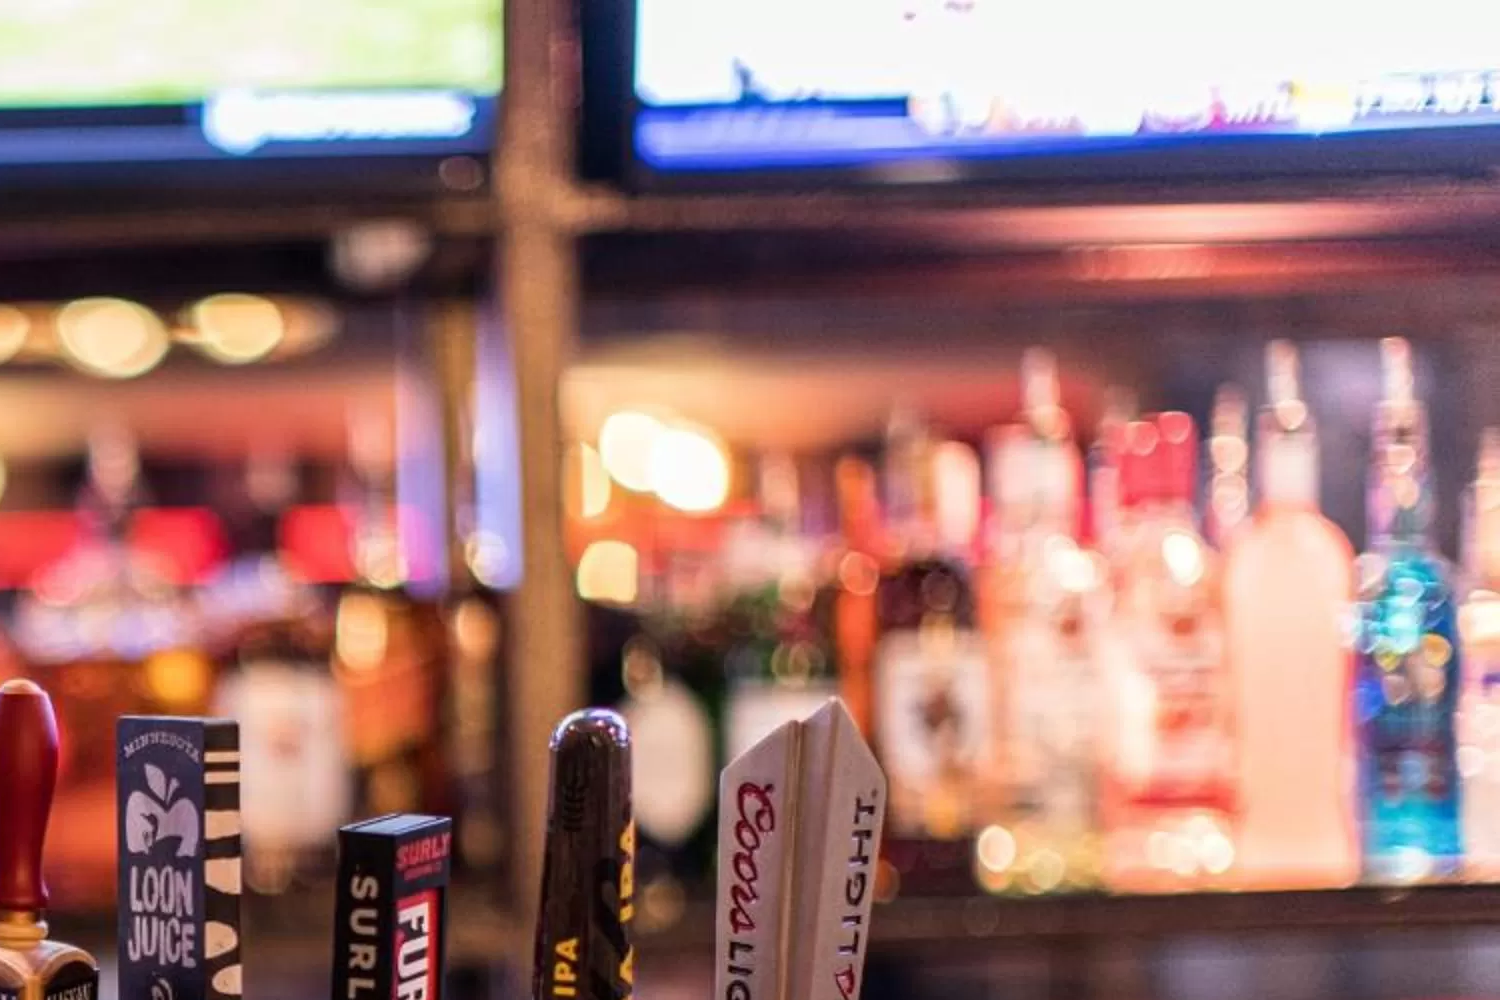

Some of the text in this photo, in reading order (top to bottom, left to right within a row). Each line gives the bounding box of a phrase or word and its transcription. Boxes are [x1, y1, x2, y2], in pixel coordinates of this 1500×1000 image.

[123, 732, 200, 764] MINNESOTA
[728, 780, 775, 936] Coors
[838, 797, 877, 957] LIGHT
[129, 865, 194, 917] LOON
[128, 916, 197, 968] JUICE
[553, 937, 579, 995] IPA
